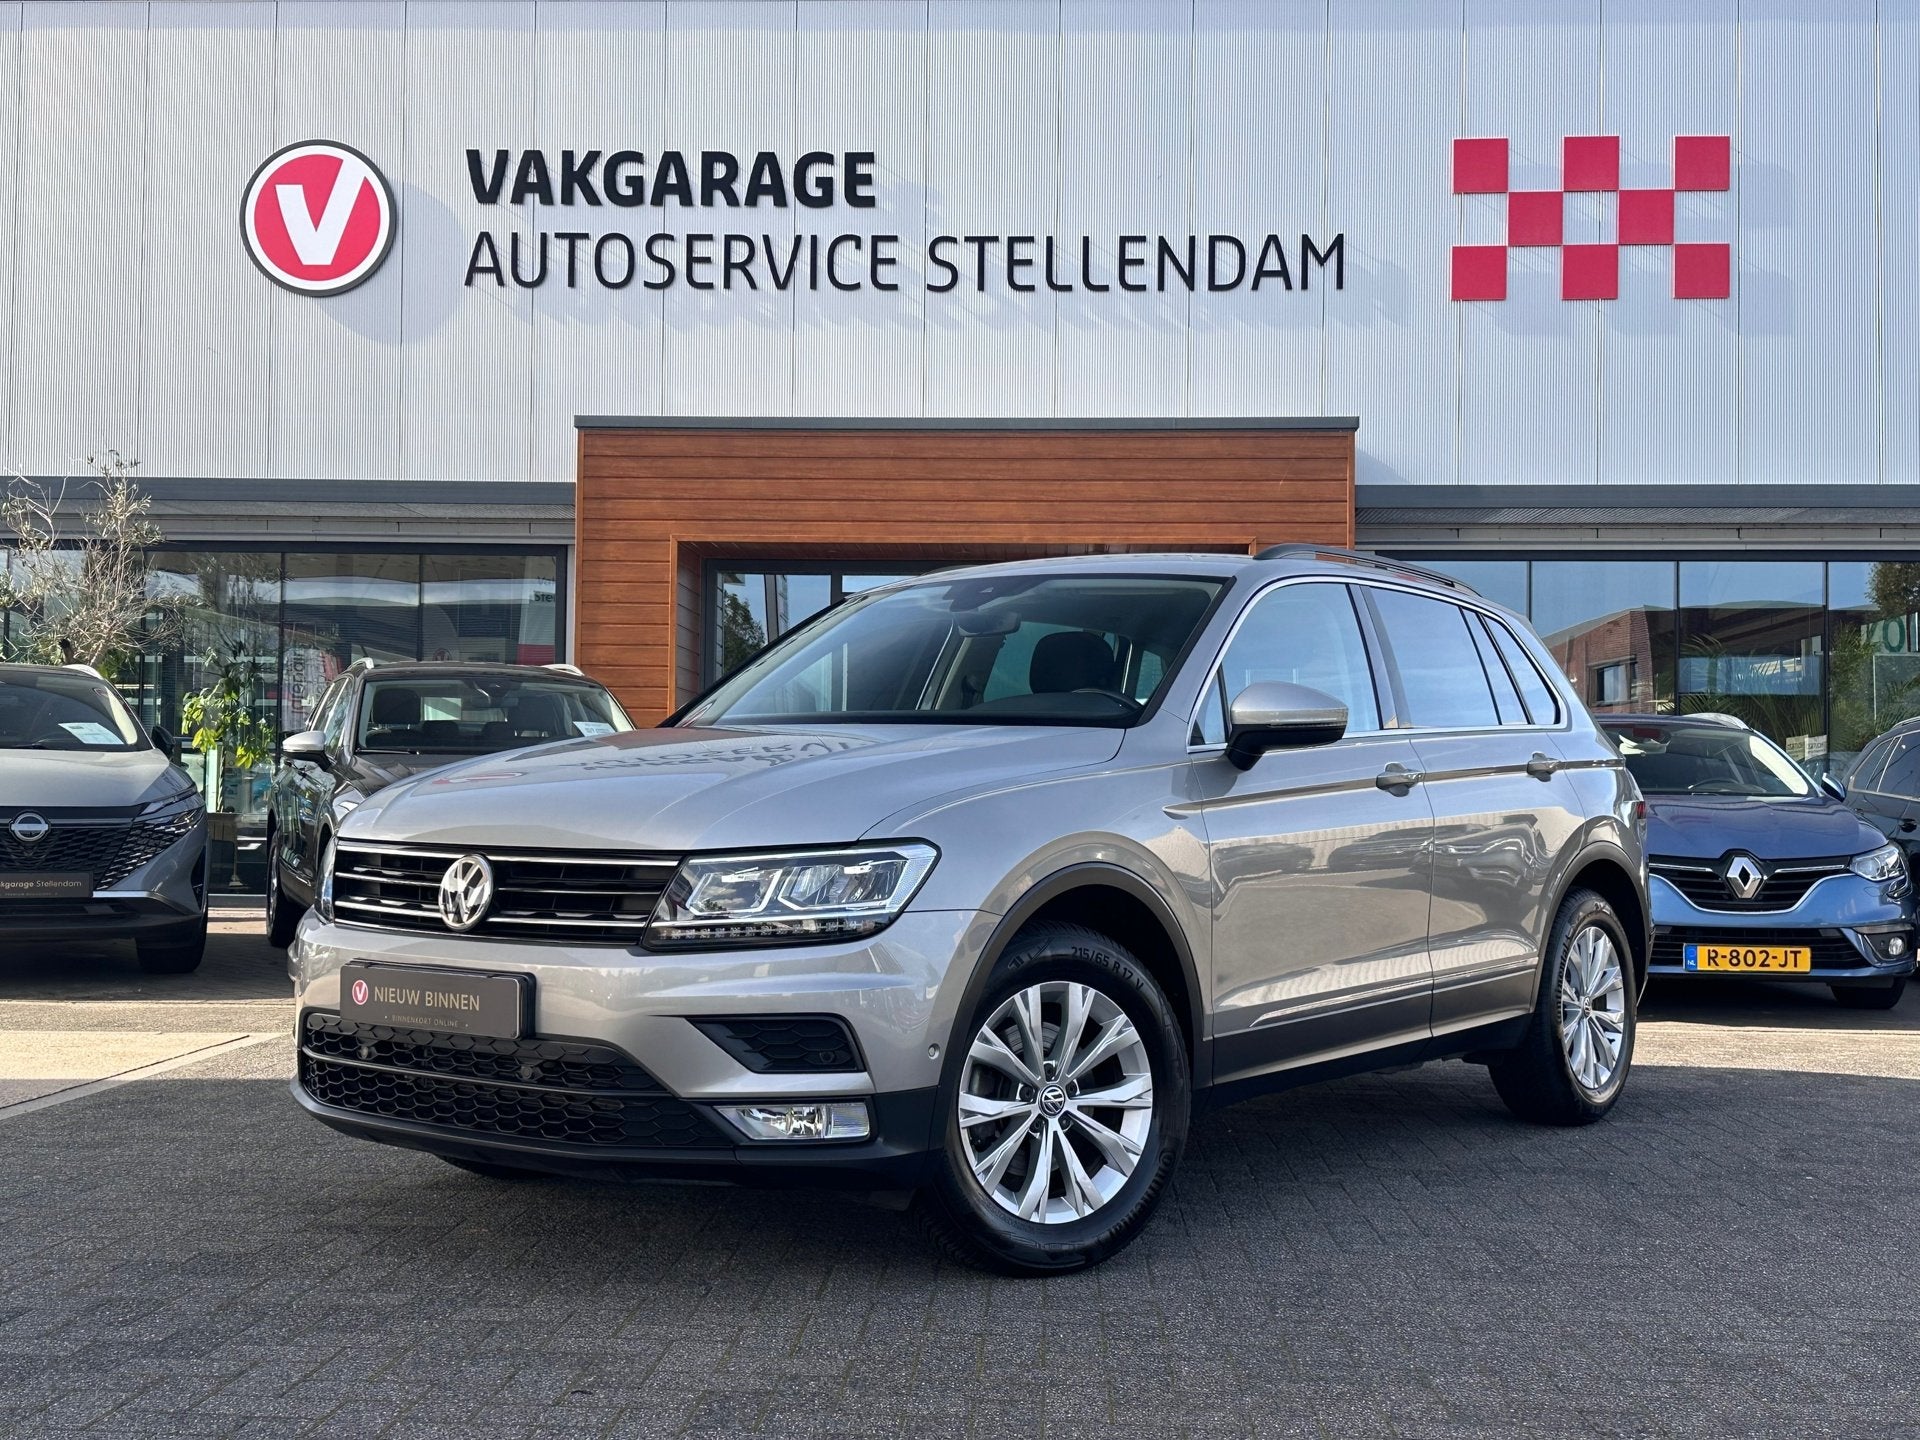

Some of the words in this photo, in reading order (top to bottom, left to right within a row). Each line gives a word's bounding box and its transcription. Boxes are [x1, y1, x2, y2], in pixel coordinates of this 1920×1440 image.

[465, 148, 876, 208] VAKGARAGE
[274, 157, 367, 266] V
[464, 231, 899, 292] AUTOSERVICE
[926, 233, 1345, 292] STELLENDAM
[1071, 946, 1110, 968] 215/65
[1112, 960, 1121, 973] R
[1122, 967, 1134, 979] 17
[1707, 949, 1802, 968] R-802-JT
[374, 986, 420, 1006] NIEUW
[425, 991, 480, 1011] BINNEN
[392, 1014, 431, 1026] BINNENKORT
[434, 1018, 459, 1028] ONLINE
